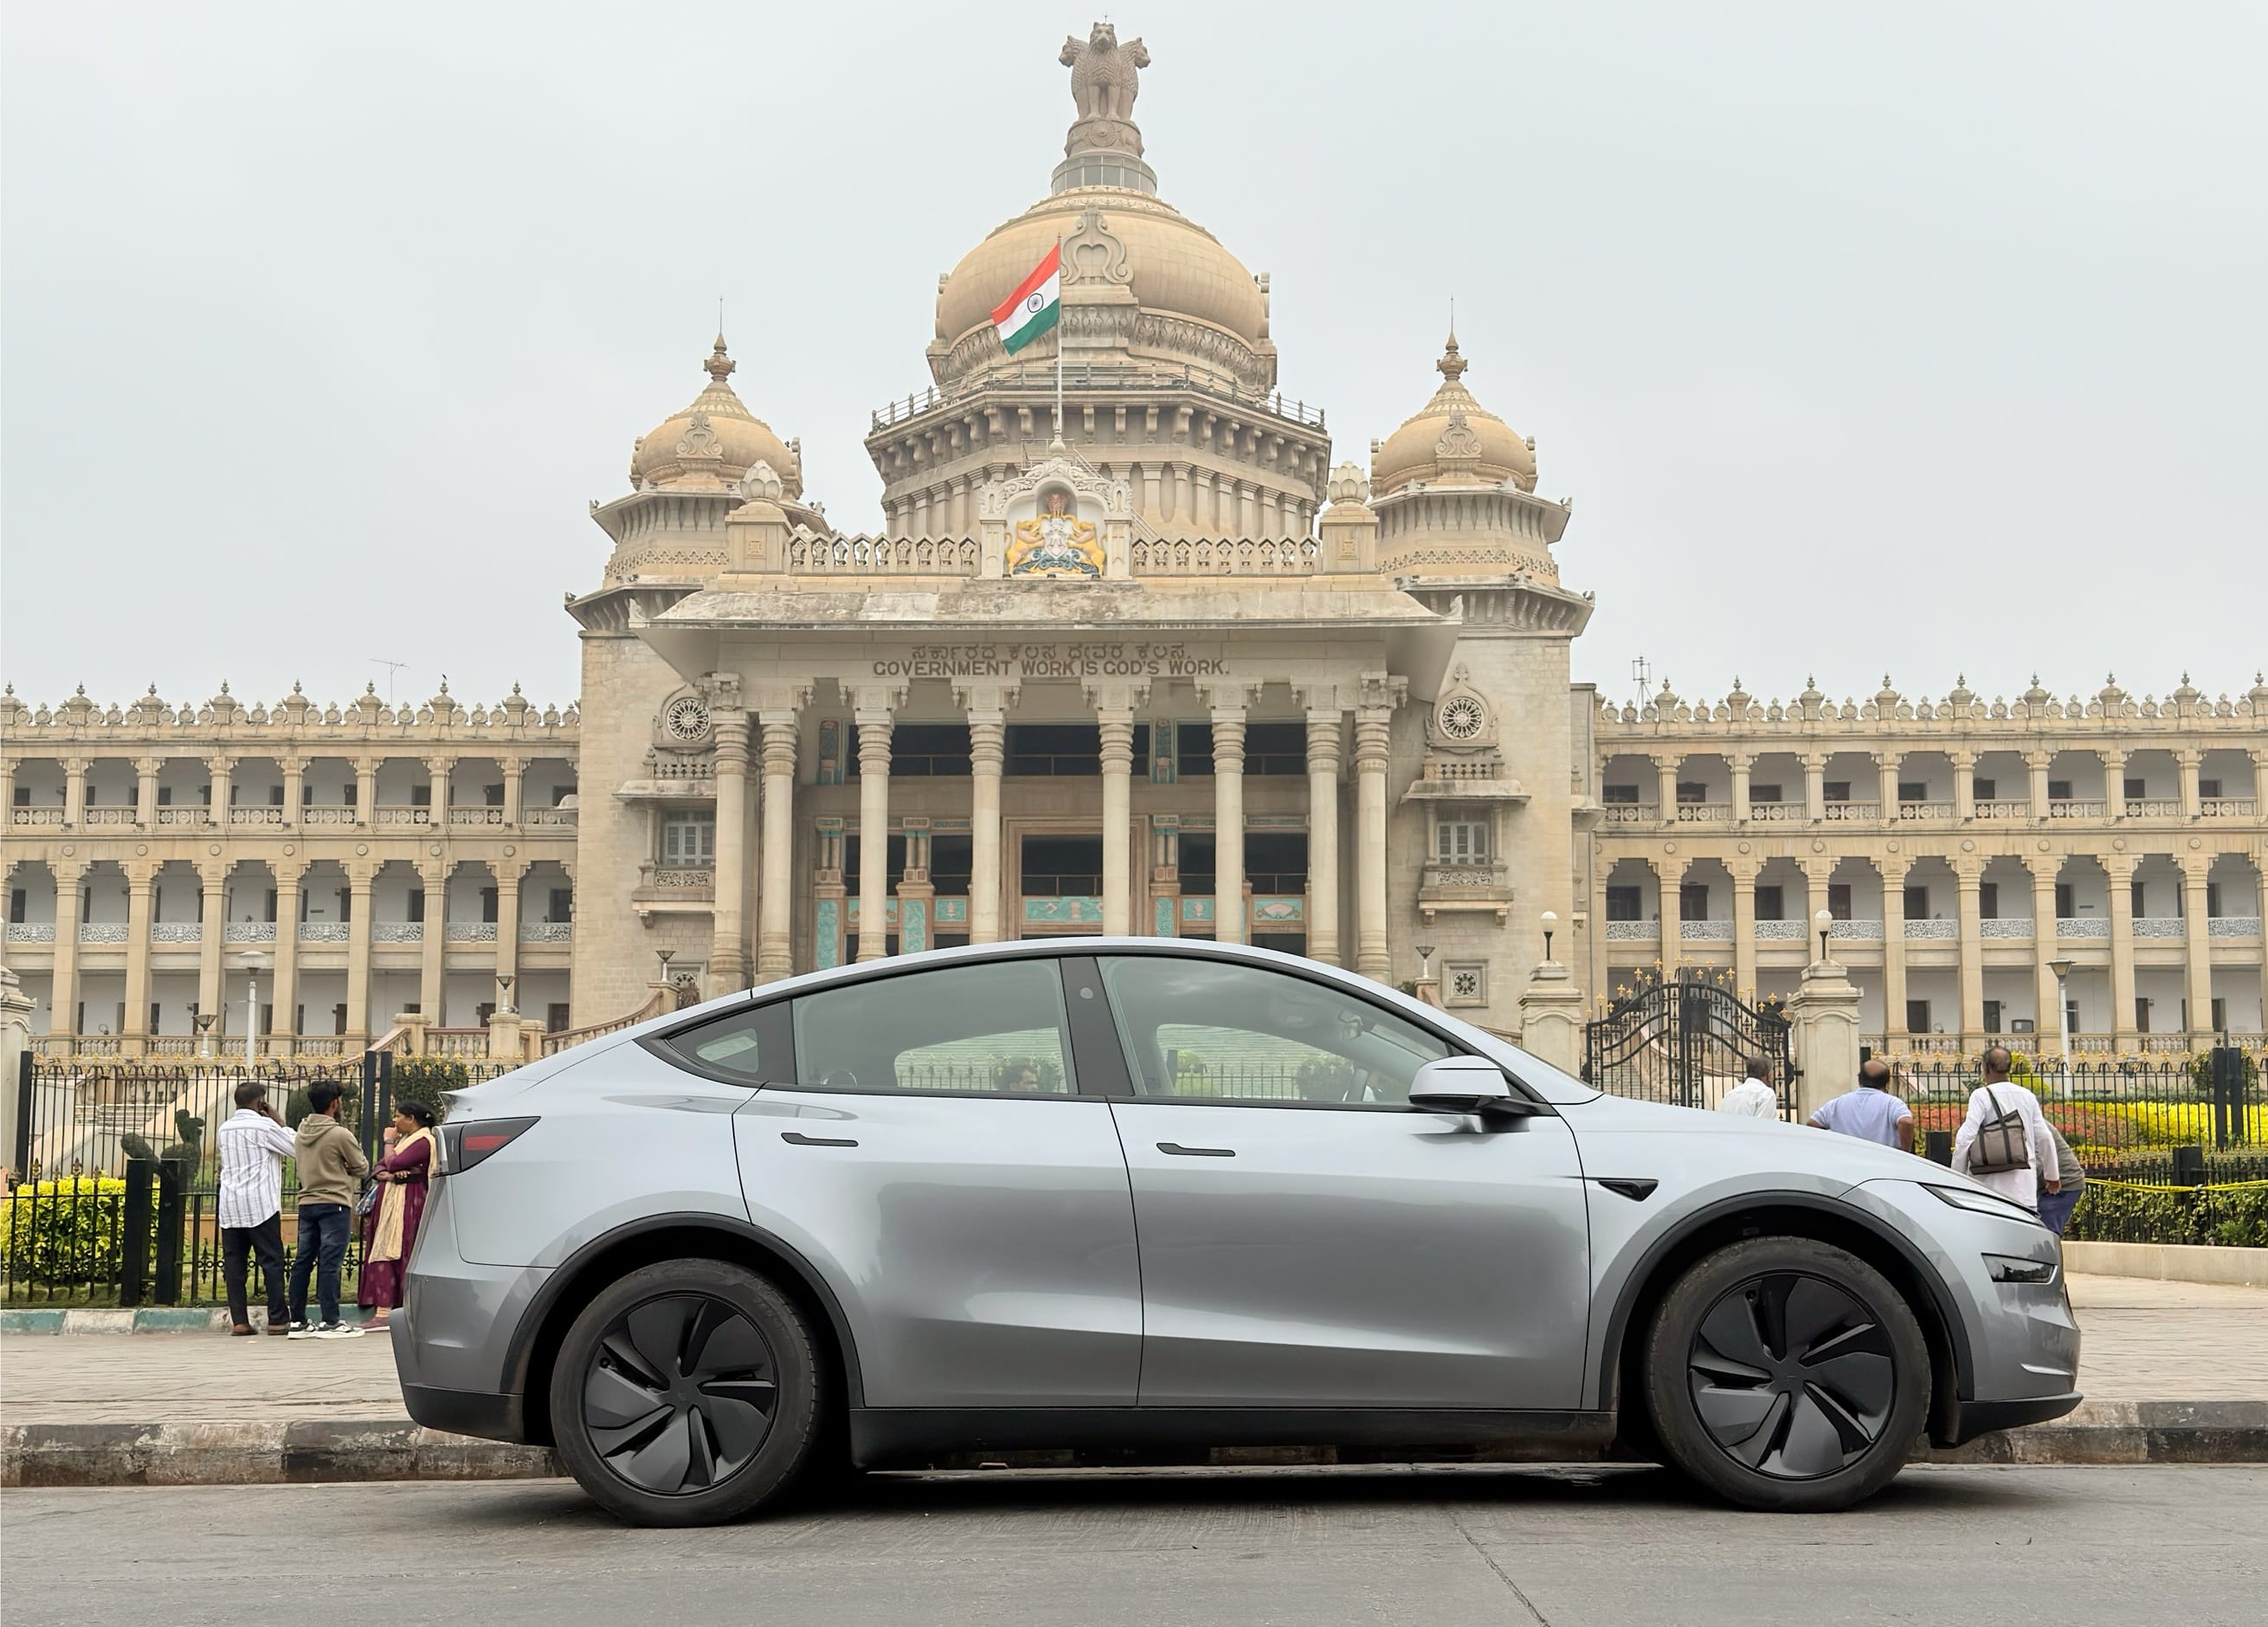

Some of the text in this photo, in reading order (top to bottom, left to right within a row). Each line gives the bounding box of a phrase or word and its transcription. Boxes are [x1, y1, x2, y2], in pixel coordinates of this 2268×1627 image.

[912, 643, 996, 660] ಸರ್ಕಾರದ
[1008, 643, 1056, 660] ಕೆಲಸ
[1068, 643, 1124, 660] ದೇವರ
[873, 659, 1229, 676] GOVERNMENT WORK IS GOD'S WORK.
